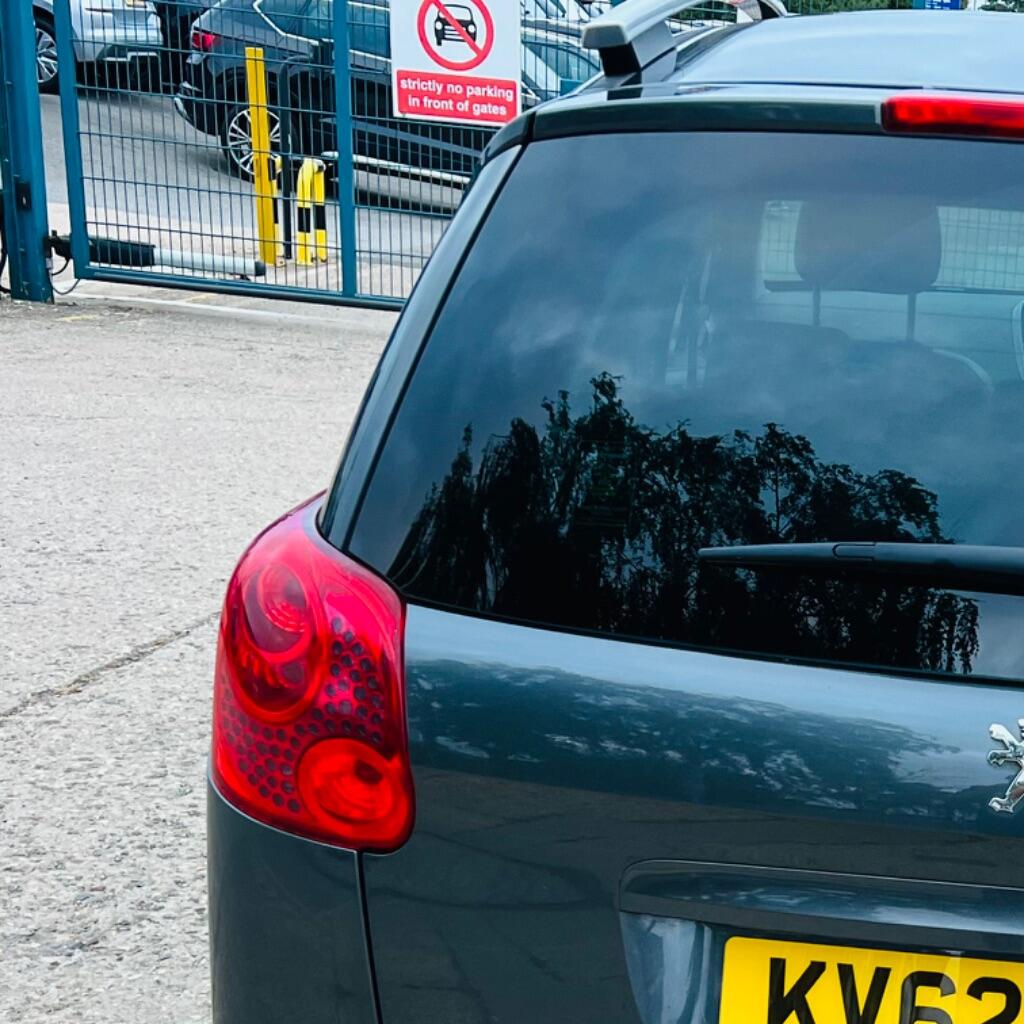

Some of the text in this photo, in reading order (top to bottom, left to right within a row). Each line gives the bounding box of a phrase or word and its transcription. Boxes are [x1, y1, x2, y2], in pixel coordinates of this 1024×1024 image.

[400, 78, 514, 101] strictly no parking
[408, 95, 507, 115] in front of gates
